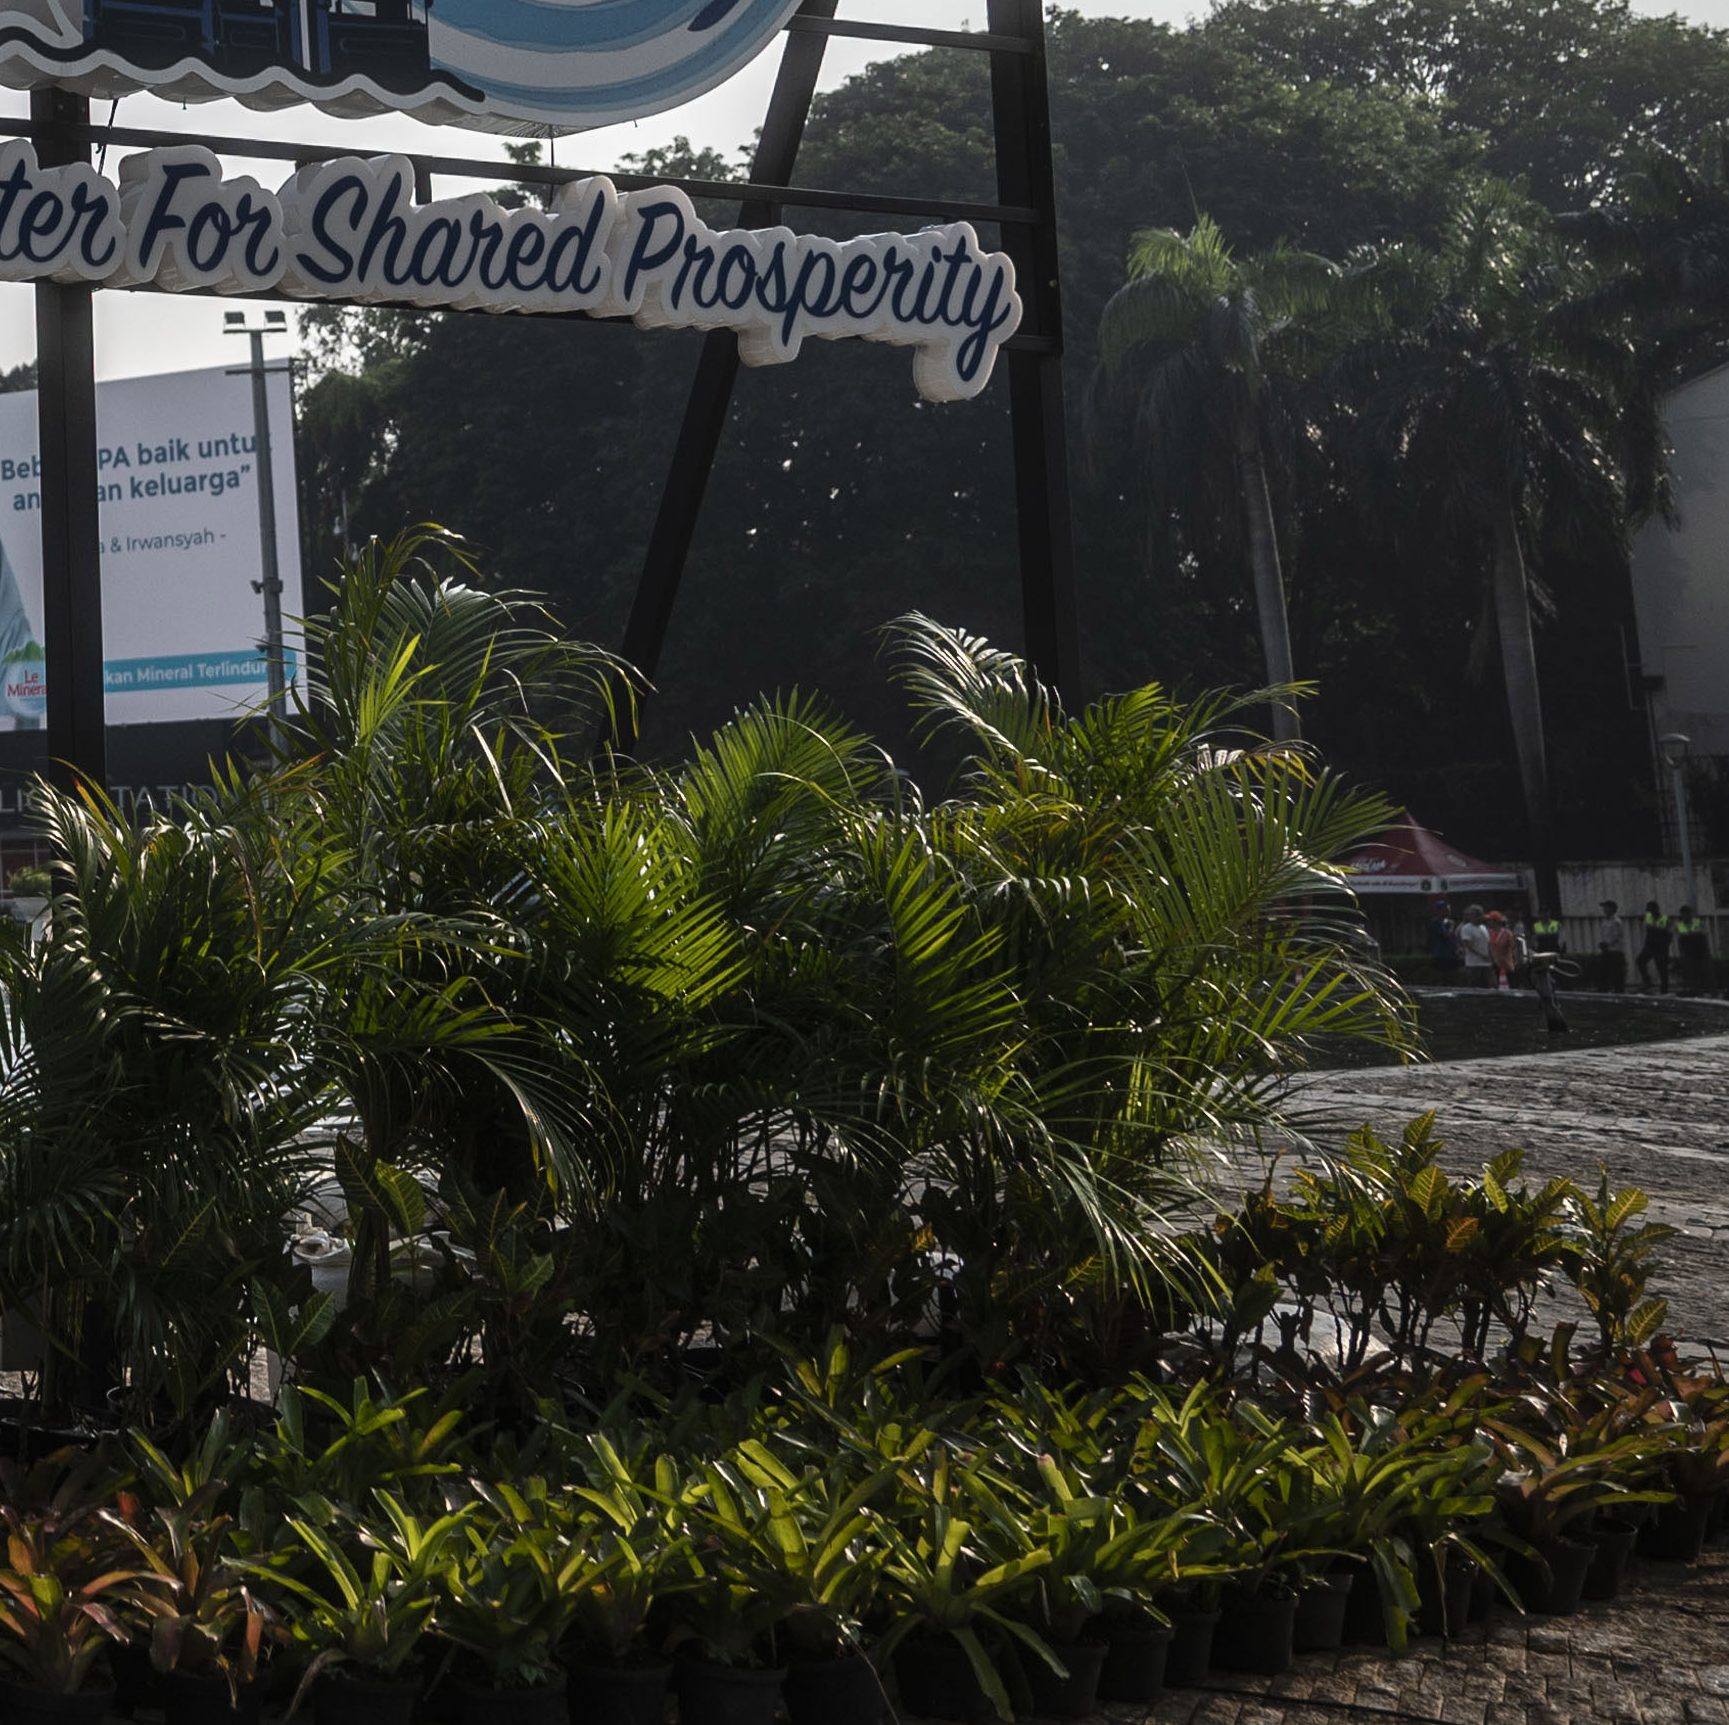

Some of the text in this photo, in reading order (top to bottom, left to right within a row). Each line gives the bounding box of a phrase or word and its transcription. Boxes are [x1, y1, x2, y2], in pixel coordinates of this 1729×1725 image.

[139, 160, 284, 281] For
[294, 174, 603, 297] Shared
[620, 199, 1013, 384] Prosperity
[137, 437, 190, 466] baik
[198, 432, 271, 459] untu
[127, 527, 215, 552] Irwansyah
[24, 669, 39, 683] Le
[137, 663, 194, 683] Mineral
[7, 682, 48, 698] Minera
